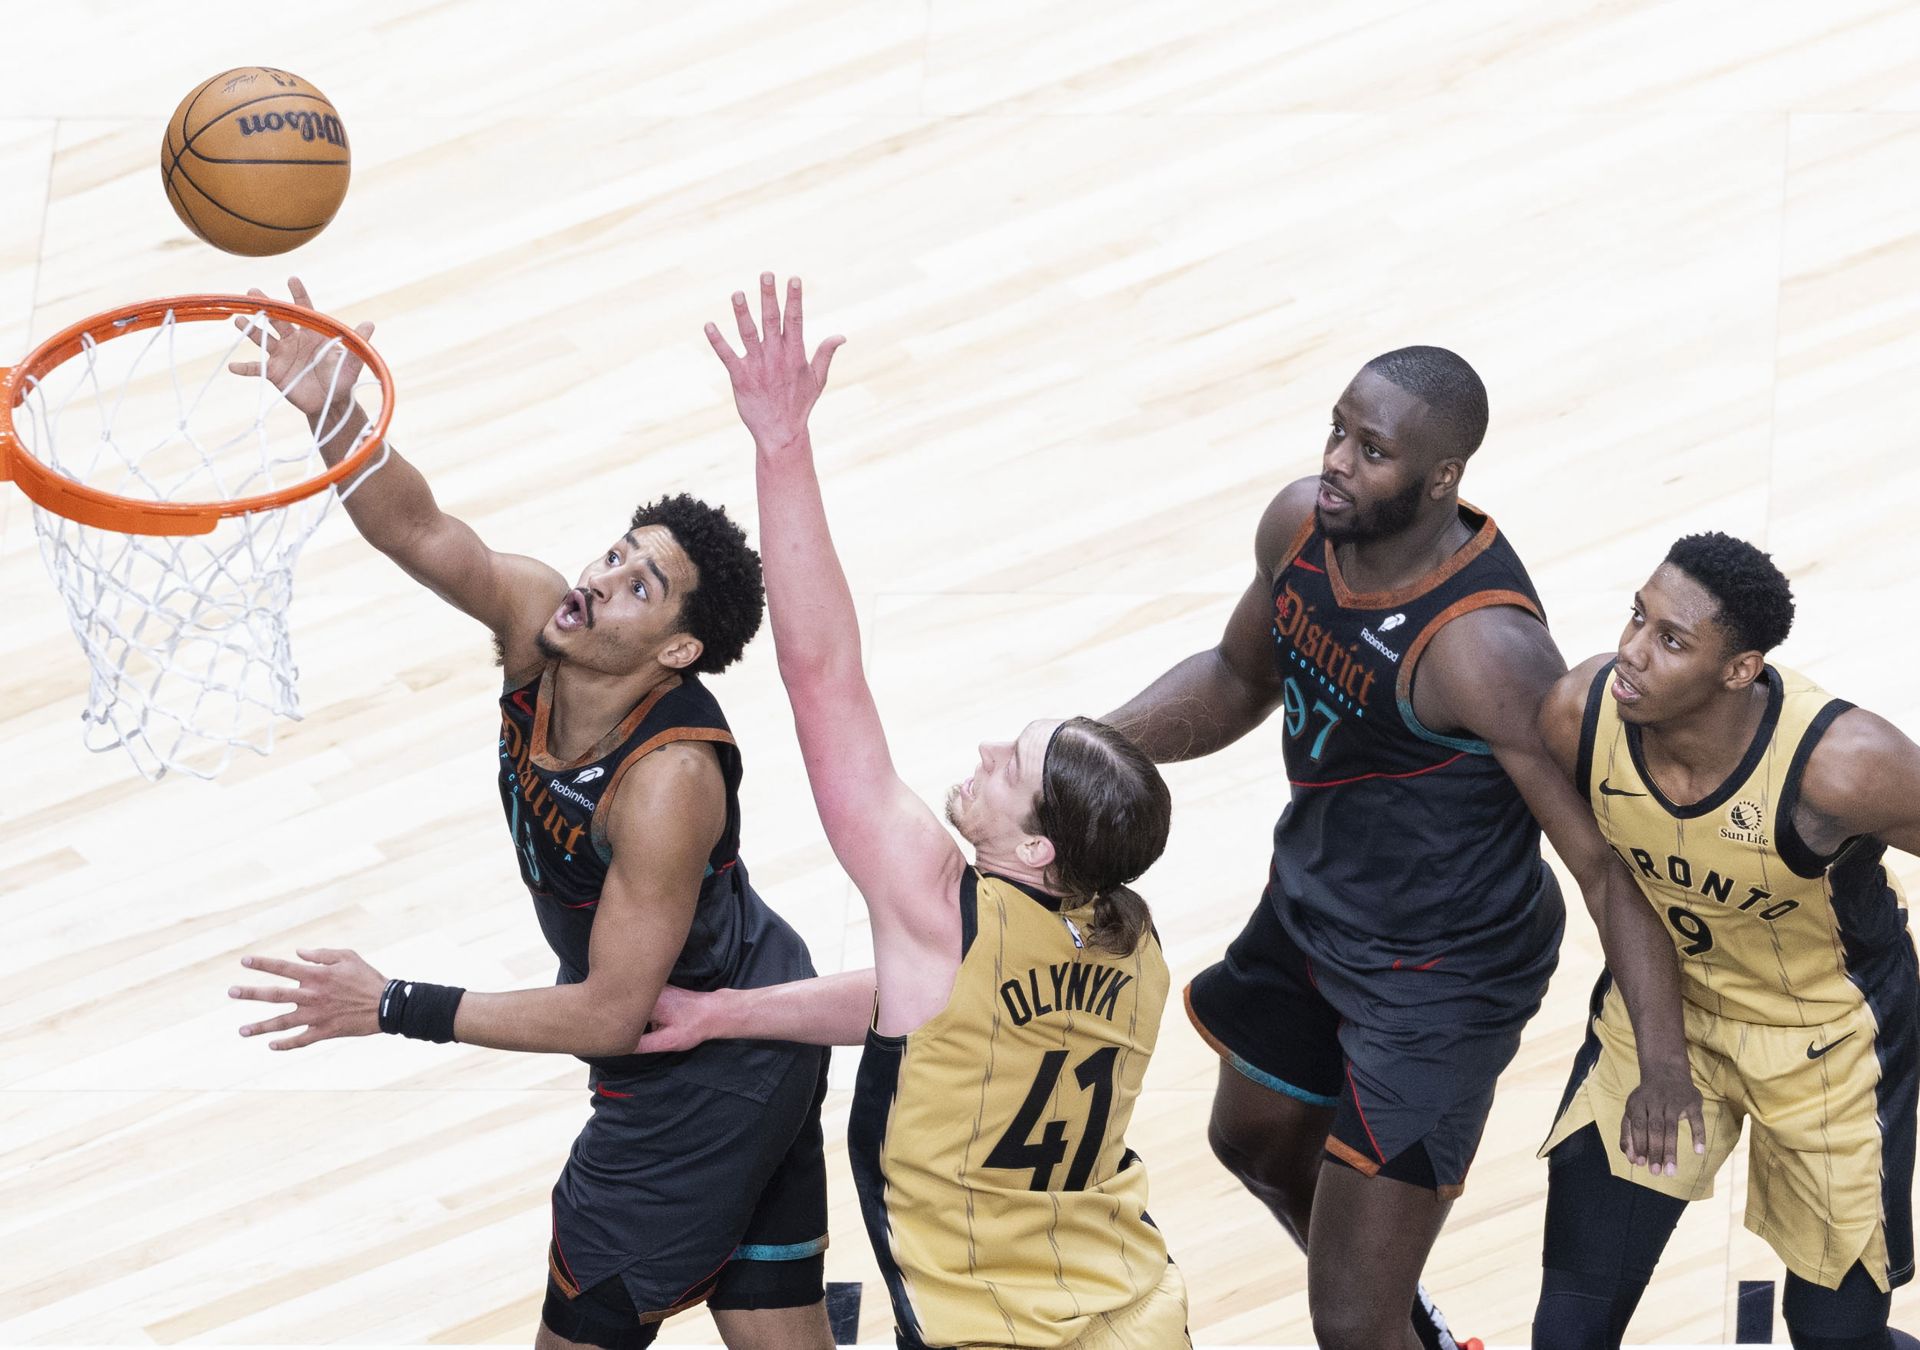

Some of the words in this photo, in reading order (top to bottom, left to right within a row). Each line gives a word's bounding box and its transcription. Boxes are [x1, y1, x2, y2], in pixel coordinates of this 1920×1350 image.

[237, 111, 347, 149] Wilson
[1275, 582, 1375, 706] District
[1361, 627, 1399, 662] Robinhood
[1290, 651, 1364, 718] COLUMBIA
[1284, 677, 1341, 760] 97
[550, 779, 596, 813] Robinhoo
[1720, 828, 1744, 841] Sun
[1747, 832, 1769, 846] Life
[1609, 843, 1800, 922] RONTO
[1666, 905, 1714, 958] 9
[999, 961, 1134, 1027] OLYNYK
[980, 1046, 1122, 1192] 41
